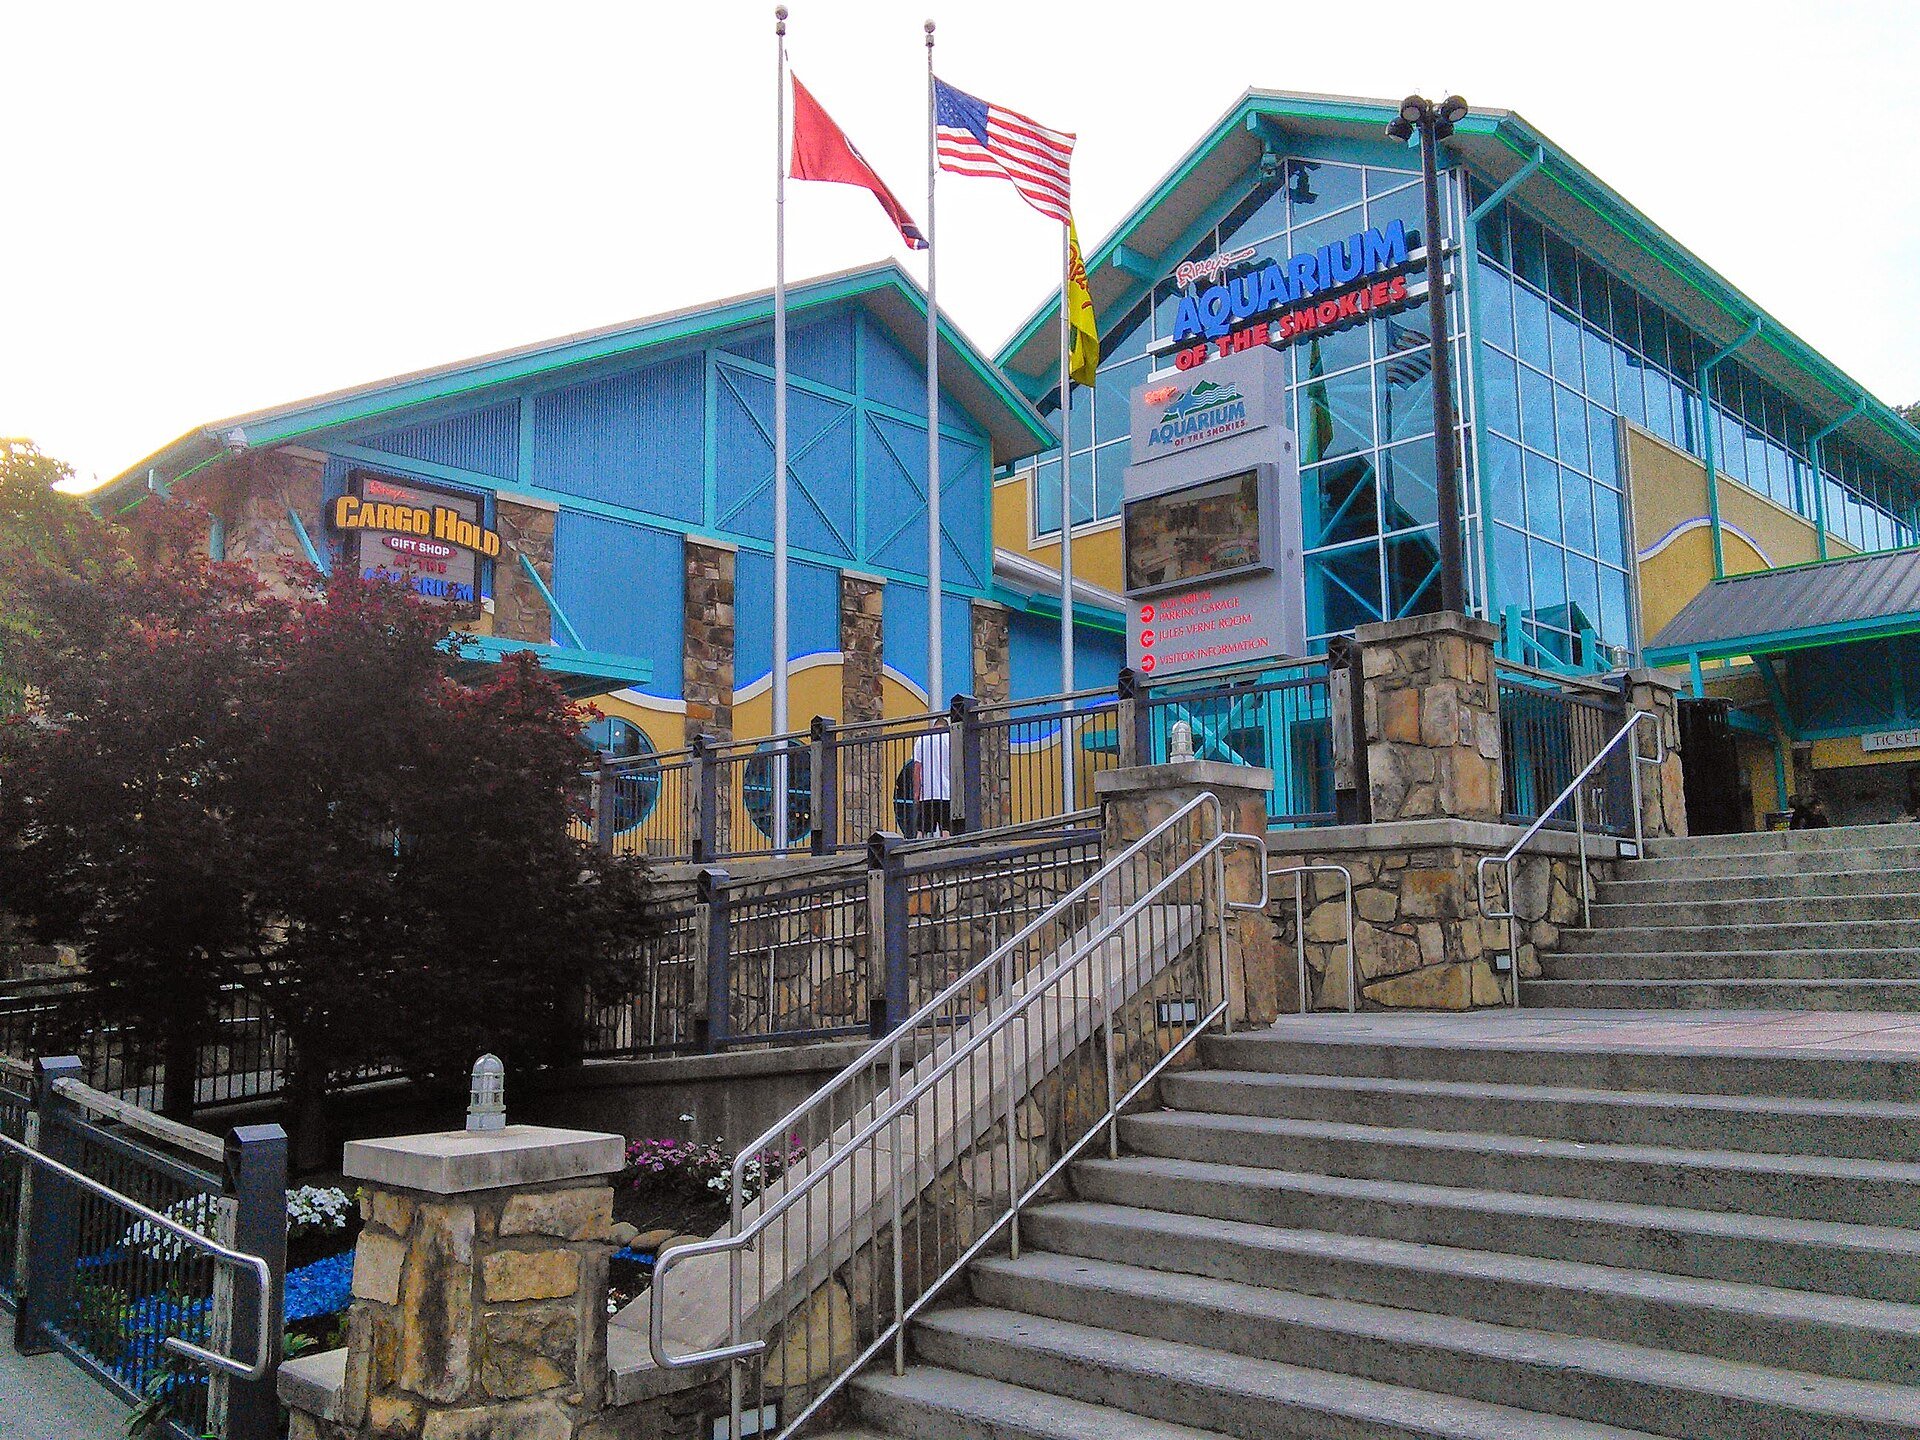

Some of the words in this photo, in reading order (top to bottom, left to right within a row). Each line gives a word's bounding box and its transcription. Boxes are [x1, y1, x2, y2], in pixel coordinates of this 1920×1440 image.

[1173, 219, 1408, 342] AQUARIUM
[1176, 248, 1255, 289] Ripley's
[1175, 342, 1208, 371] OF
[1215, 322, 1271, 358] THE
[1279, 275, 1408, 339] SMOKIES
[1148, 401, 1246, 447] AQUARIUM
[1174, 438, 1185, 447] OF
[1188, 432, 1204, 442] THE
[1207, 419, 1247, 438] SMOKIES
[391, 537, 417, 549] GIFT
[418, 543, 450, 556] SHOP
[418, 560, 447, 574] THE
[1160, 606, 1199, 622] PARKING
[1201, 596, 1240, 614] GARAGE
[1160, 627, 1184, 641] JULES
[1186, 620, 1216, 634] VERNE
[1218, 613, 1253, 629] ROOM
[1160, 651, 1196, 665] VISITOR
[1198, 637, 1269, 658] INFORMATION
